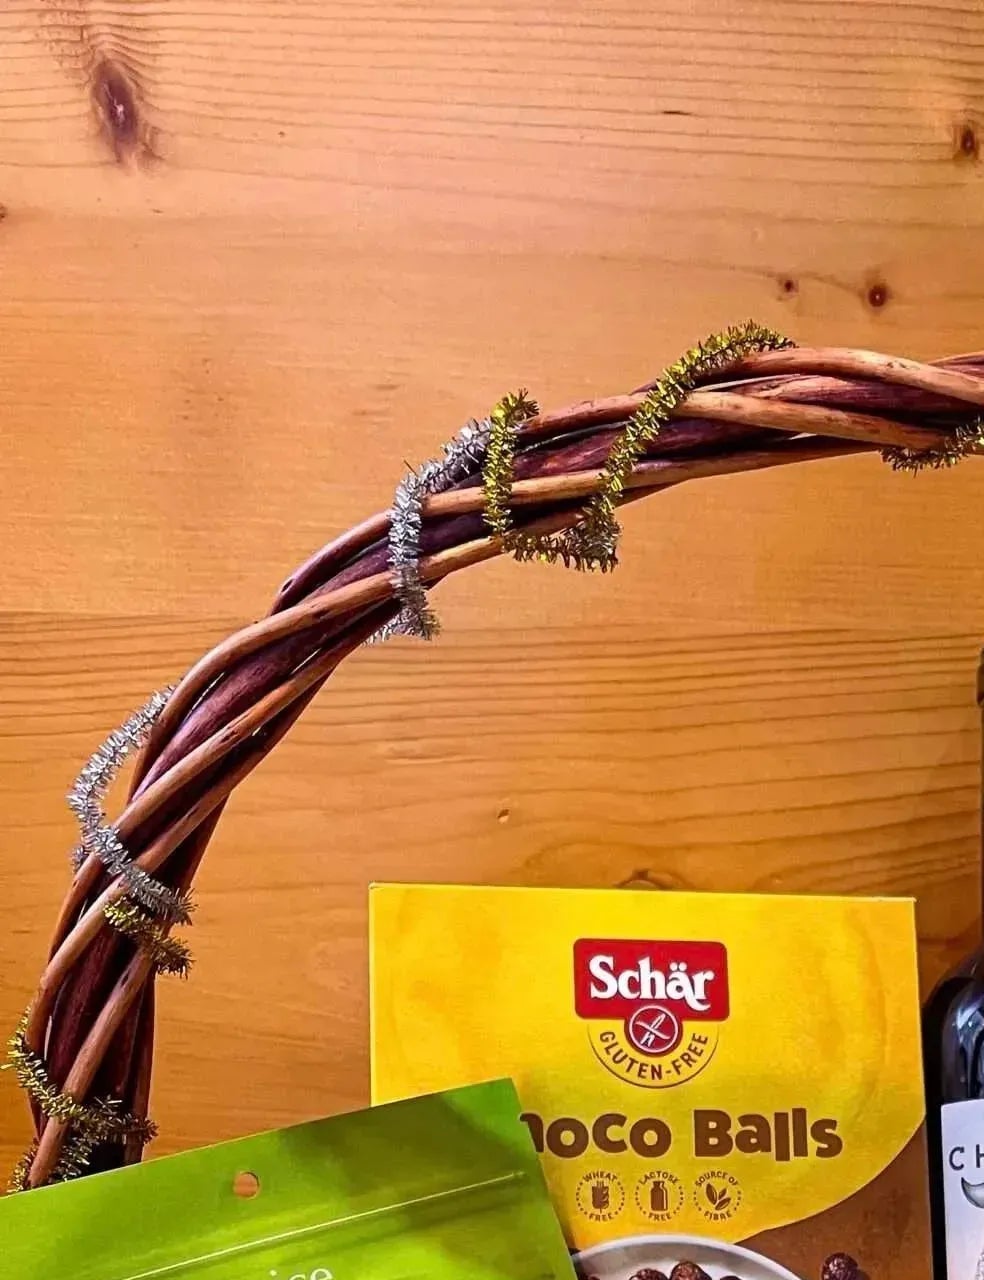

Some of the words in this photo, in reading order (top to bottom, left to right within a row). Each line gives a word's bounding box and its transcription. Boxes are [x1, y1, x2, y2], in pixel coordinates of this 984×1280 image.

[589, 955, 715, 1011] Schär
[599, 1031, 708, 1080] GLUTEN-FREE
[693, 1107, 844, 1162] Balls
[582, 1171, 618, 1183] WHEAT
[638, 1170, 680, 1185] LACTOSE
[695, 1170, 727, 1187] SOURCE
[588, 1212, 613, 1222] FREE
[648, 1212, 672, 1222] FREE
[704, 1210, 732, 1222] FIBRE
